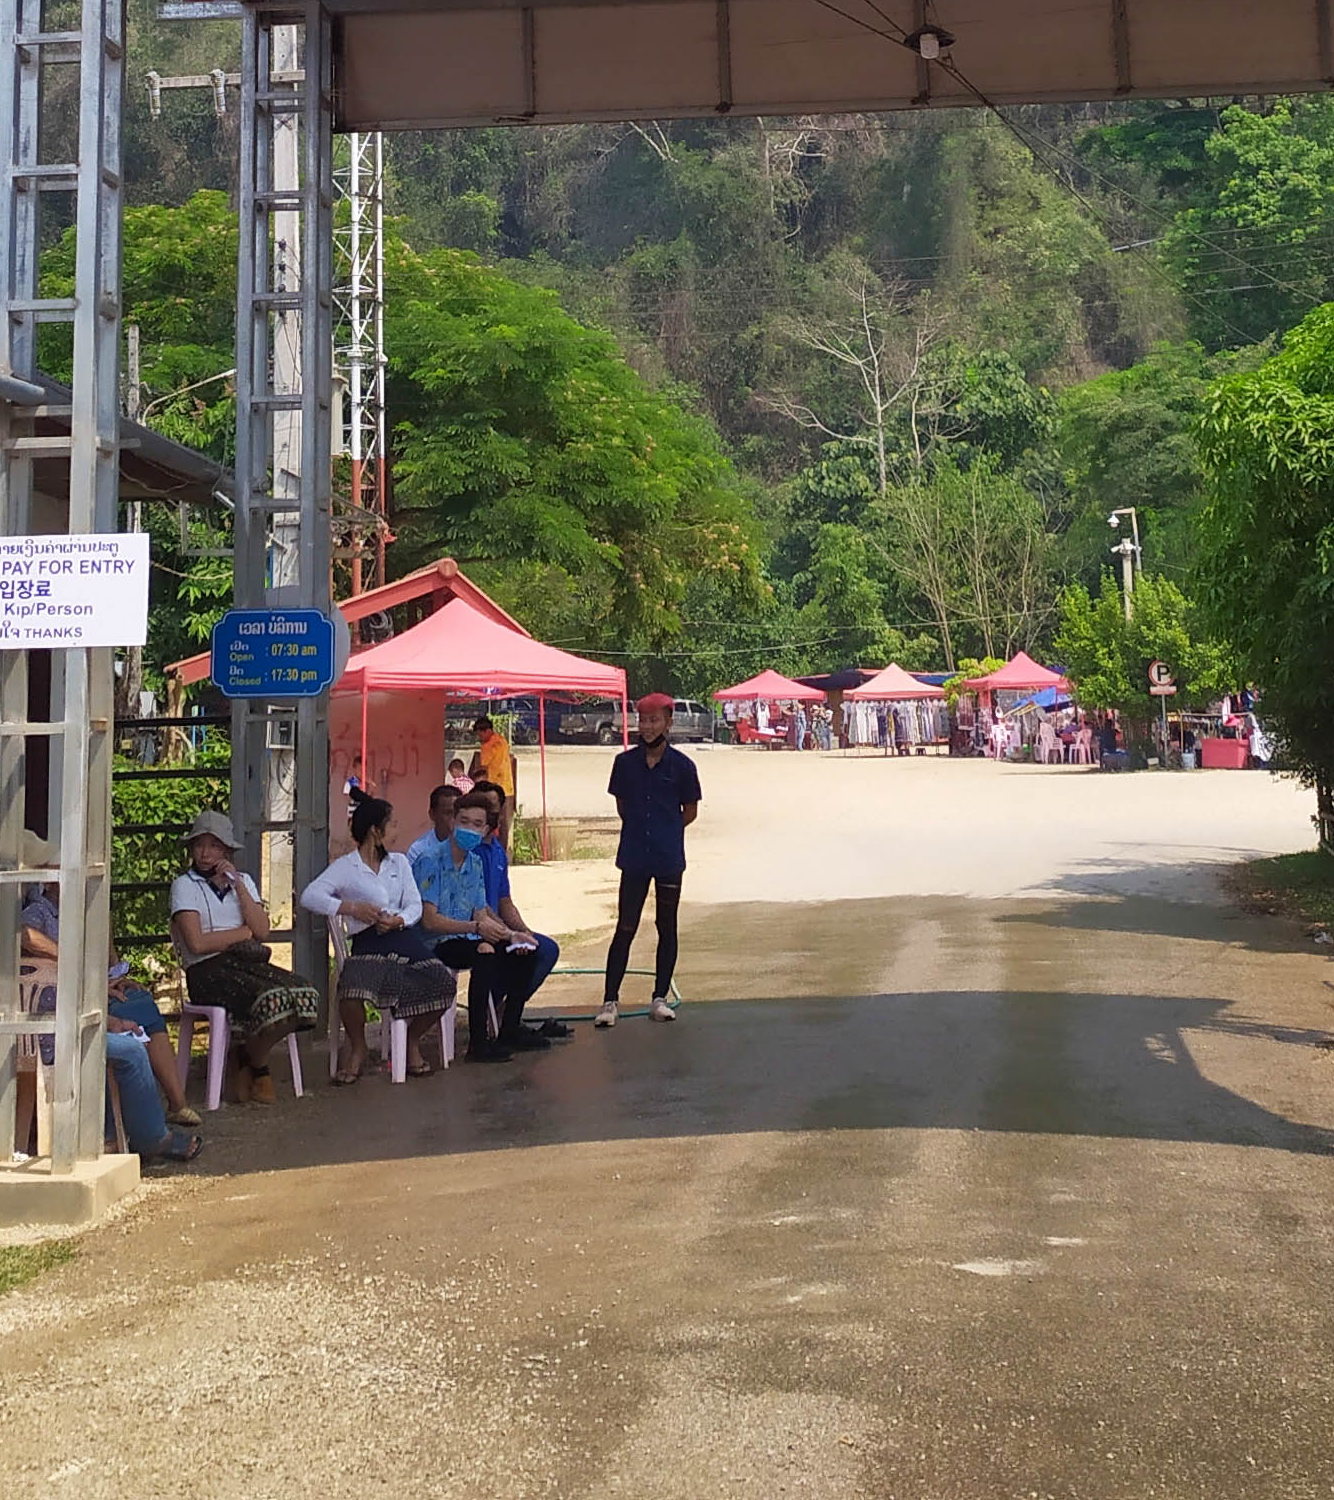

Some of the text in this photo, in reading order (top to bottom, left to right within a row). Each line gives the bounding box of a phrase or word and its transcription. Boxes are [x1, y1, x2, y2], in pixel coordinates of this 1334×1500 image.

[2, 561, 34, 575] PAY
[39, 560, 73, 575] FOR
[80, 560, 135, 574] ENTRY
[0, 580, 52, 599] 입장료
[4, 602, 93, 619] Kip/Person
[24, 627, 83, 638] THANKS
[229, 652, 254, 662] Open
[271, 643, 299, 656] 07:30
[301, 645, 317, 656] am
[271, 668, 299, 681] 17:30
[301, 670, 317, 683] pm
[1157, 665, 1170, 681] P
